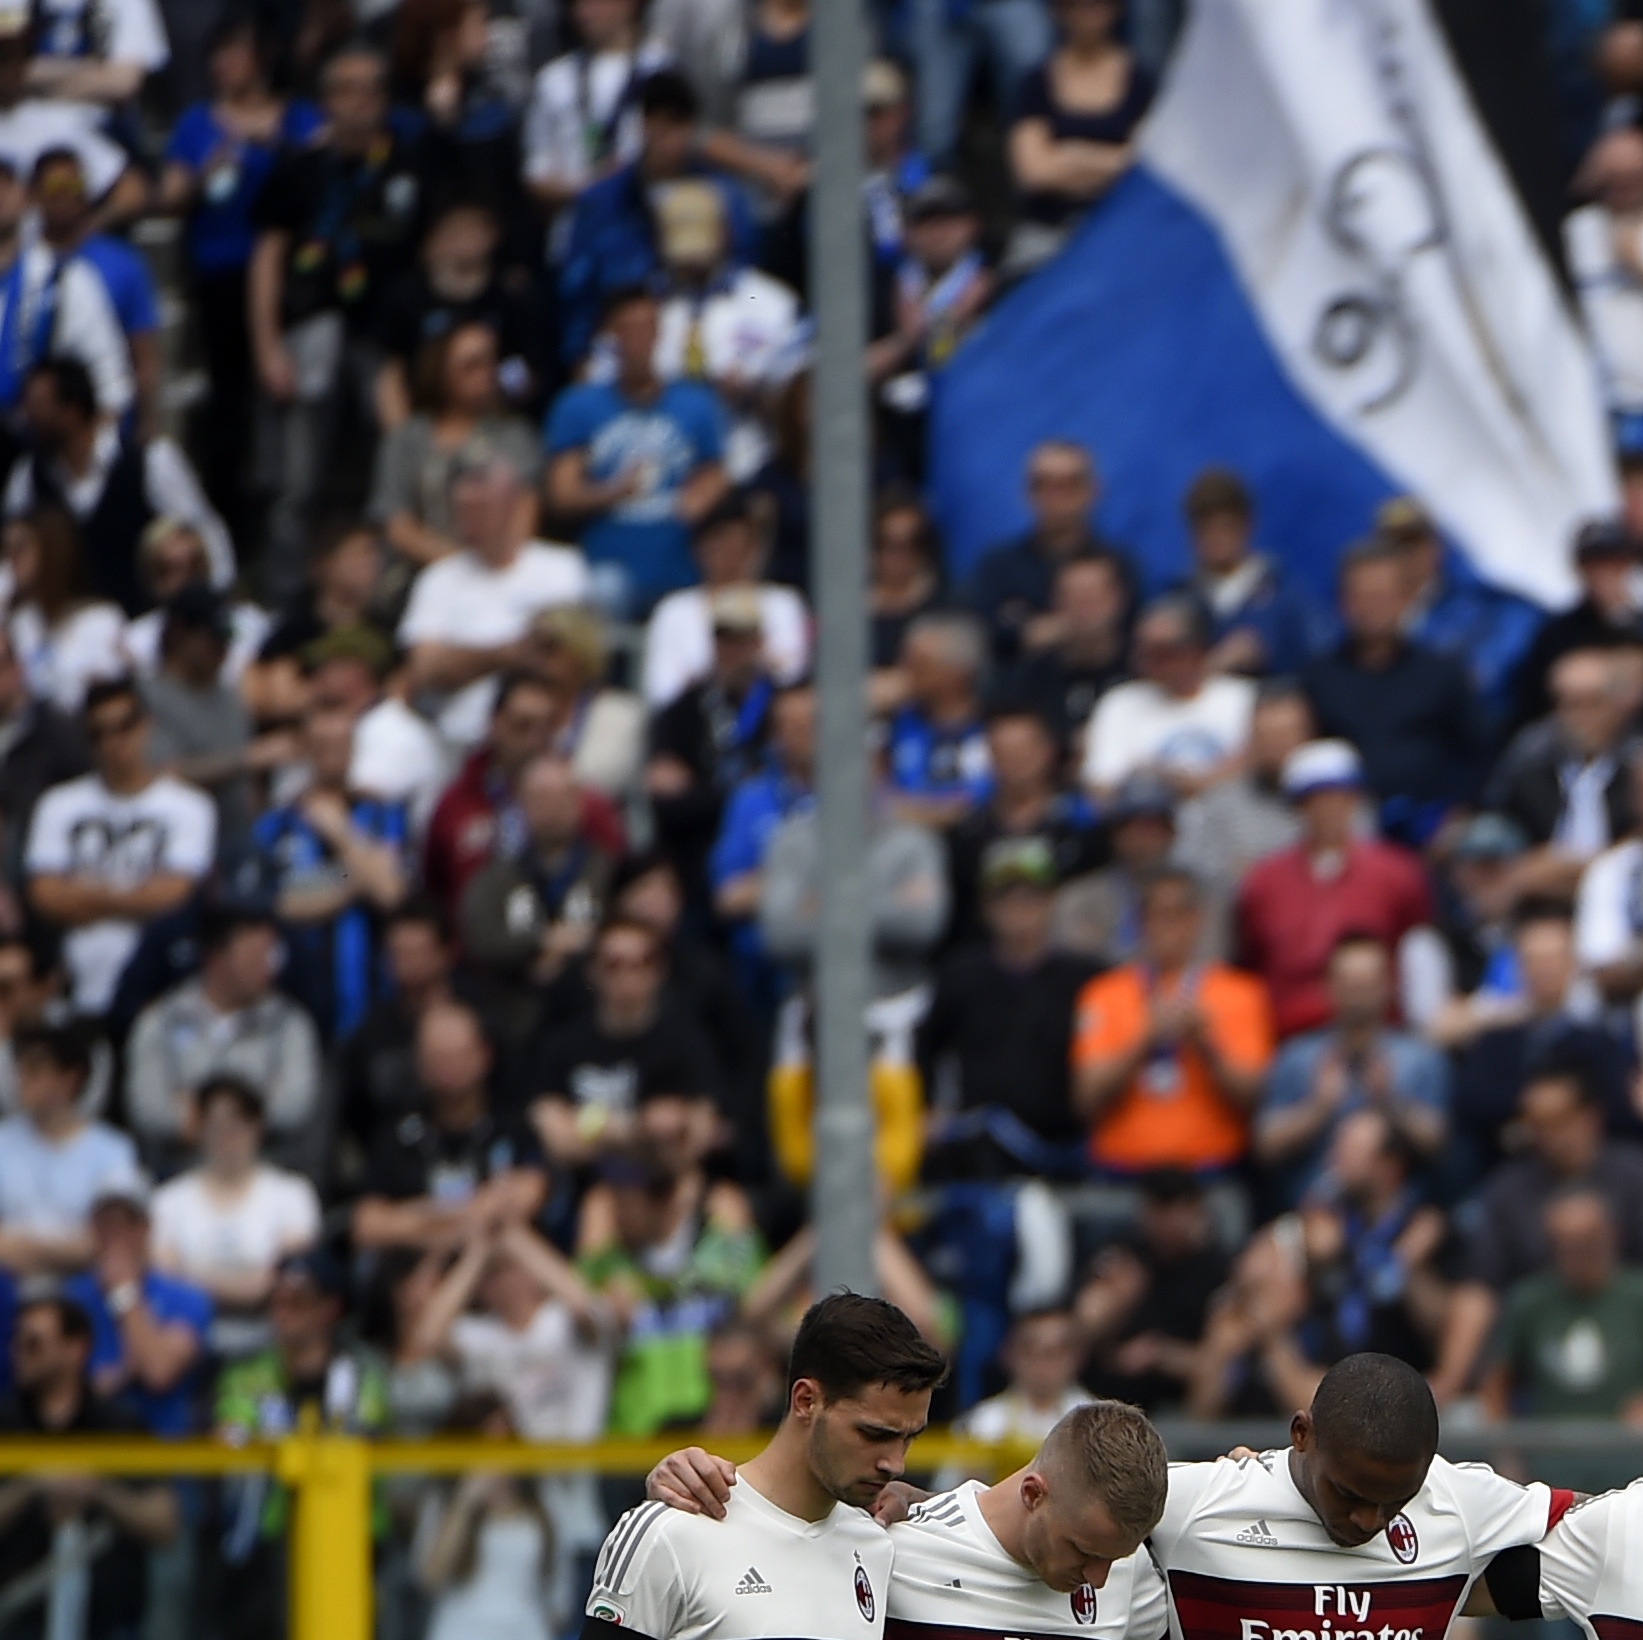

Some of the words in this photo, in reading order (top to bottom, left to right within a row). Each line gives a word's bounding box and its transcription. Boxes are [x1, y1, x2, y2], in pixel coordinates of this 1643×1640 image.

[1236, 1531, 1279, 1546] adidas
[735, 1583, 773, 1595] adidas
[1313, 1585, 1371, 1622] Fly
